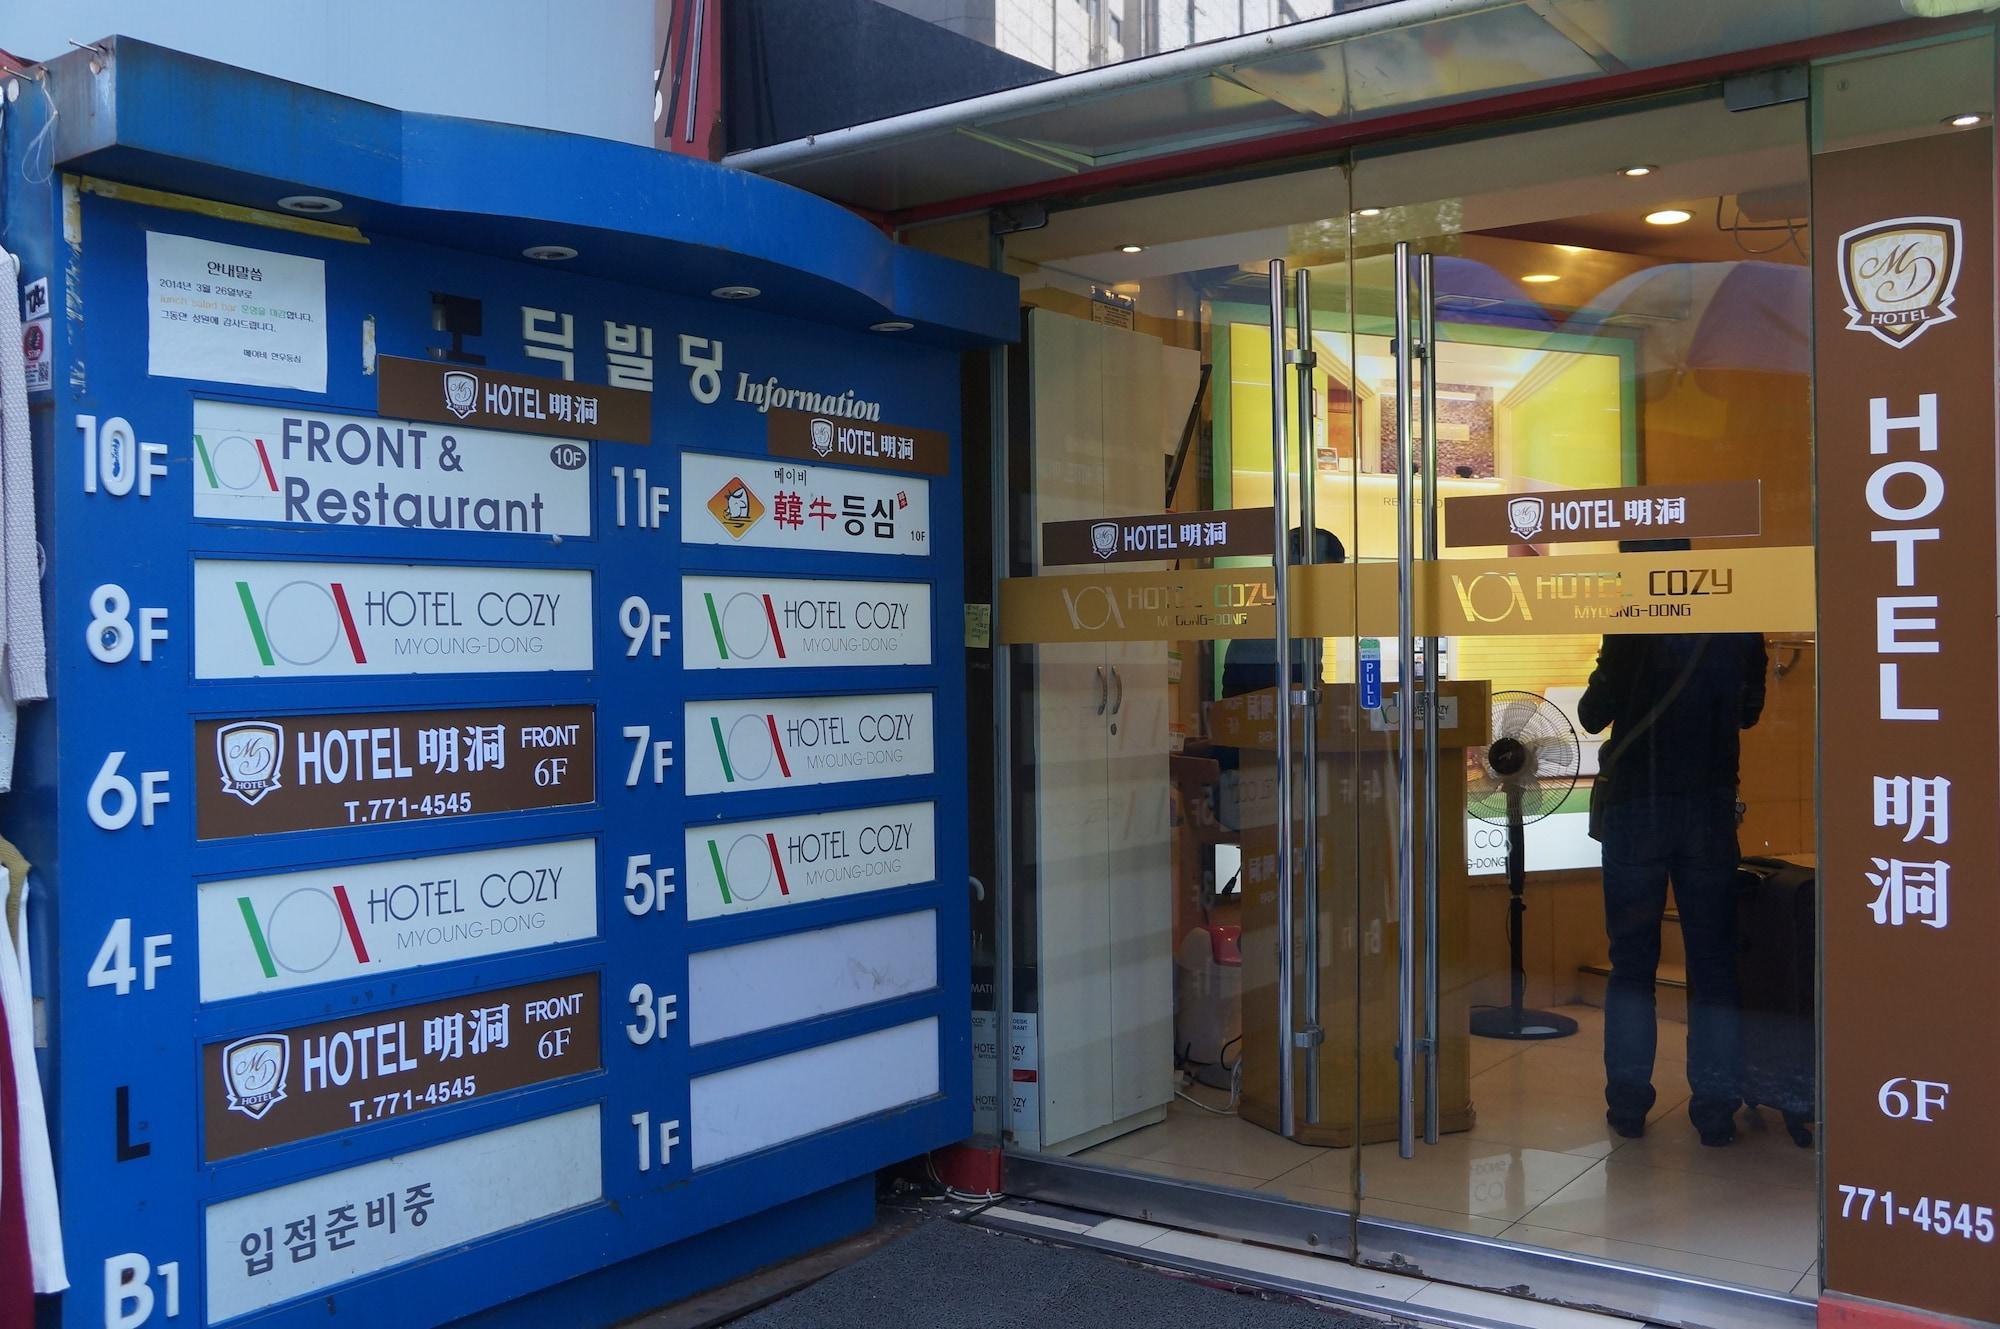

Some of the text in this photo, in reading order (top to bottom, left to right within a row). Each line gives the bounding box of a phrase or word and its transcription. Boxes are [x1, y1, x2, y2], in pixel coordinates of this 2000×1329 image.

[159, 278, 192, 292] 2014년
[196, 283, 211, 293] 3월
[207, 260, 263, 282] 안내말씀
[160, 309, 188, 321] 그동안
[223, 316, 277, 333] 감사드립니다.
[1870, 307, 1931, 325] HOTEL
[485, 382, 598, 425] HOTEL 明洞
[736, 371, 881, 422] Information
[75, 413, 168, 498] 10F
[282, 417, 464, 472] FRONT &
[554, 447, 582, 468] 10F
[837, 427, 914, 460] HOTEL 明洞
[610, 466, 670, 529] 11F
[774, 467, 807, 486] 메이비
[285, 476, 543, 533] Restaurant
[1551, 497, 1686, 530] HOTEL 明洞
[910, 530, 926, 542] 10F
[1124, 521, 1227, 551] HOTEL 明洞
[1865, 393, 1945, 721] HOTEL
[1649, 568, 1733, 596] COZY
[86, 583, 168, 664] 8F
[365, 590, 560, 627] HOTEL COZY
[618, 596, 671, 658] 9F
[784, 600, 909, 631] HOTEL COZY
[393, 636, 544, 656] MYOUNG-DONG
[802, 637, 898, 653] MYOUNG-DONG
[1366, 662, 1375, 706] PULL
[520, 724, 580, 748] FRONT
[787, 713, 914, 748] HOTEL COZY
[298, 723, 506, 785] HOTEL 明洞
[533, 757, 568, 787] 6F
[622, 725, 673, 787] 7F
[807, 749, 903, 769] MYOUNG-DONG
[86, 751, 170, 831] 6F
[235, 780, 269, 790] HOTEL
[344, 792, 472, 824] T.771-4545
[788, 822, 913, 865] HOTEL COZY
[1864, 775, 1951, 928] 明洞
[624, 854, 675, 917] 5F
[806, 859, 902, 886] MYOUNG-DONG
[367, 866, 563, 924] HOTEL COZY
[396, 912, 546, 950] MYOUNG-DONG
[87, 918, 173, 995] 4F
[524, 993, 584, 1024] FRONT
[625, 982, 677, 1046] 3F
[303, 1002, 510, 1092] HOTEL 明洞
[537, 1027, 572, 1060] 6F
[241, 1092, 273, 1105] HOTEL
[349, 1075, 476, 1124] T.771-4545
[1877, 1077, 1950, 1122] 6F
[116, 1085, 150, 1162] L
[631, 1111, 680, 1172] 1F
[239, 1182, 435, 1277] 입점준비중
[1838, 1183, 1995, 1243] 771-4545
[103, 1251, 179, 1329] B1
